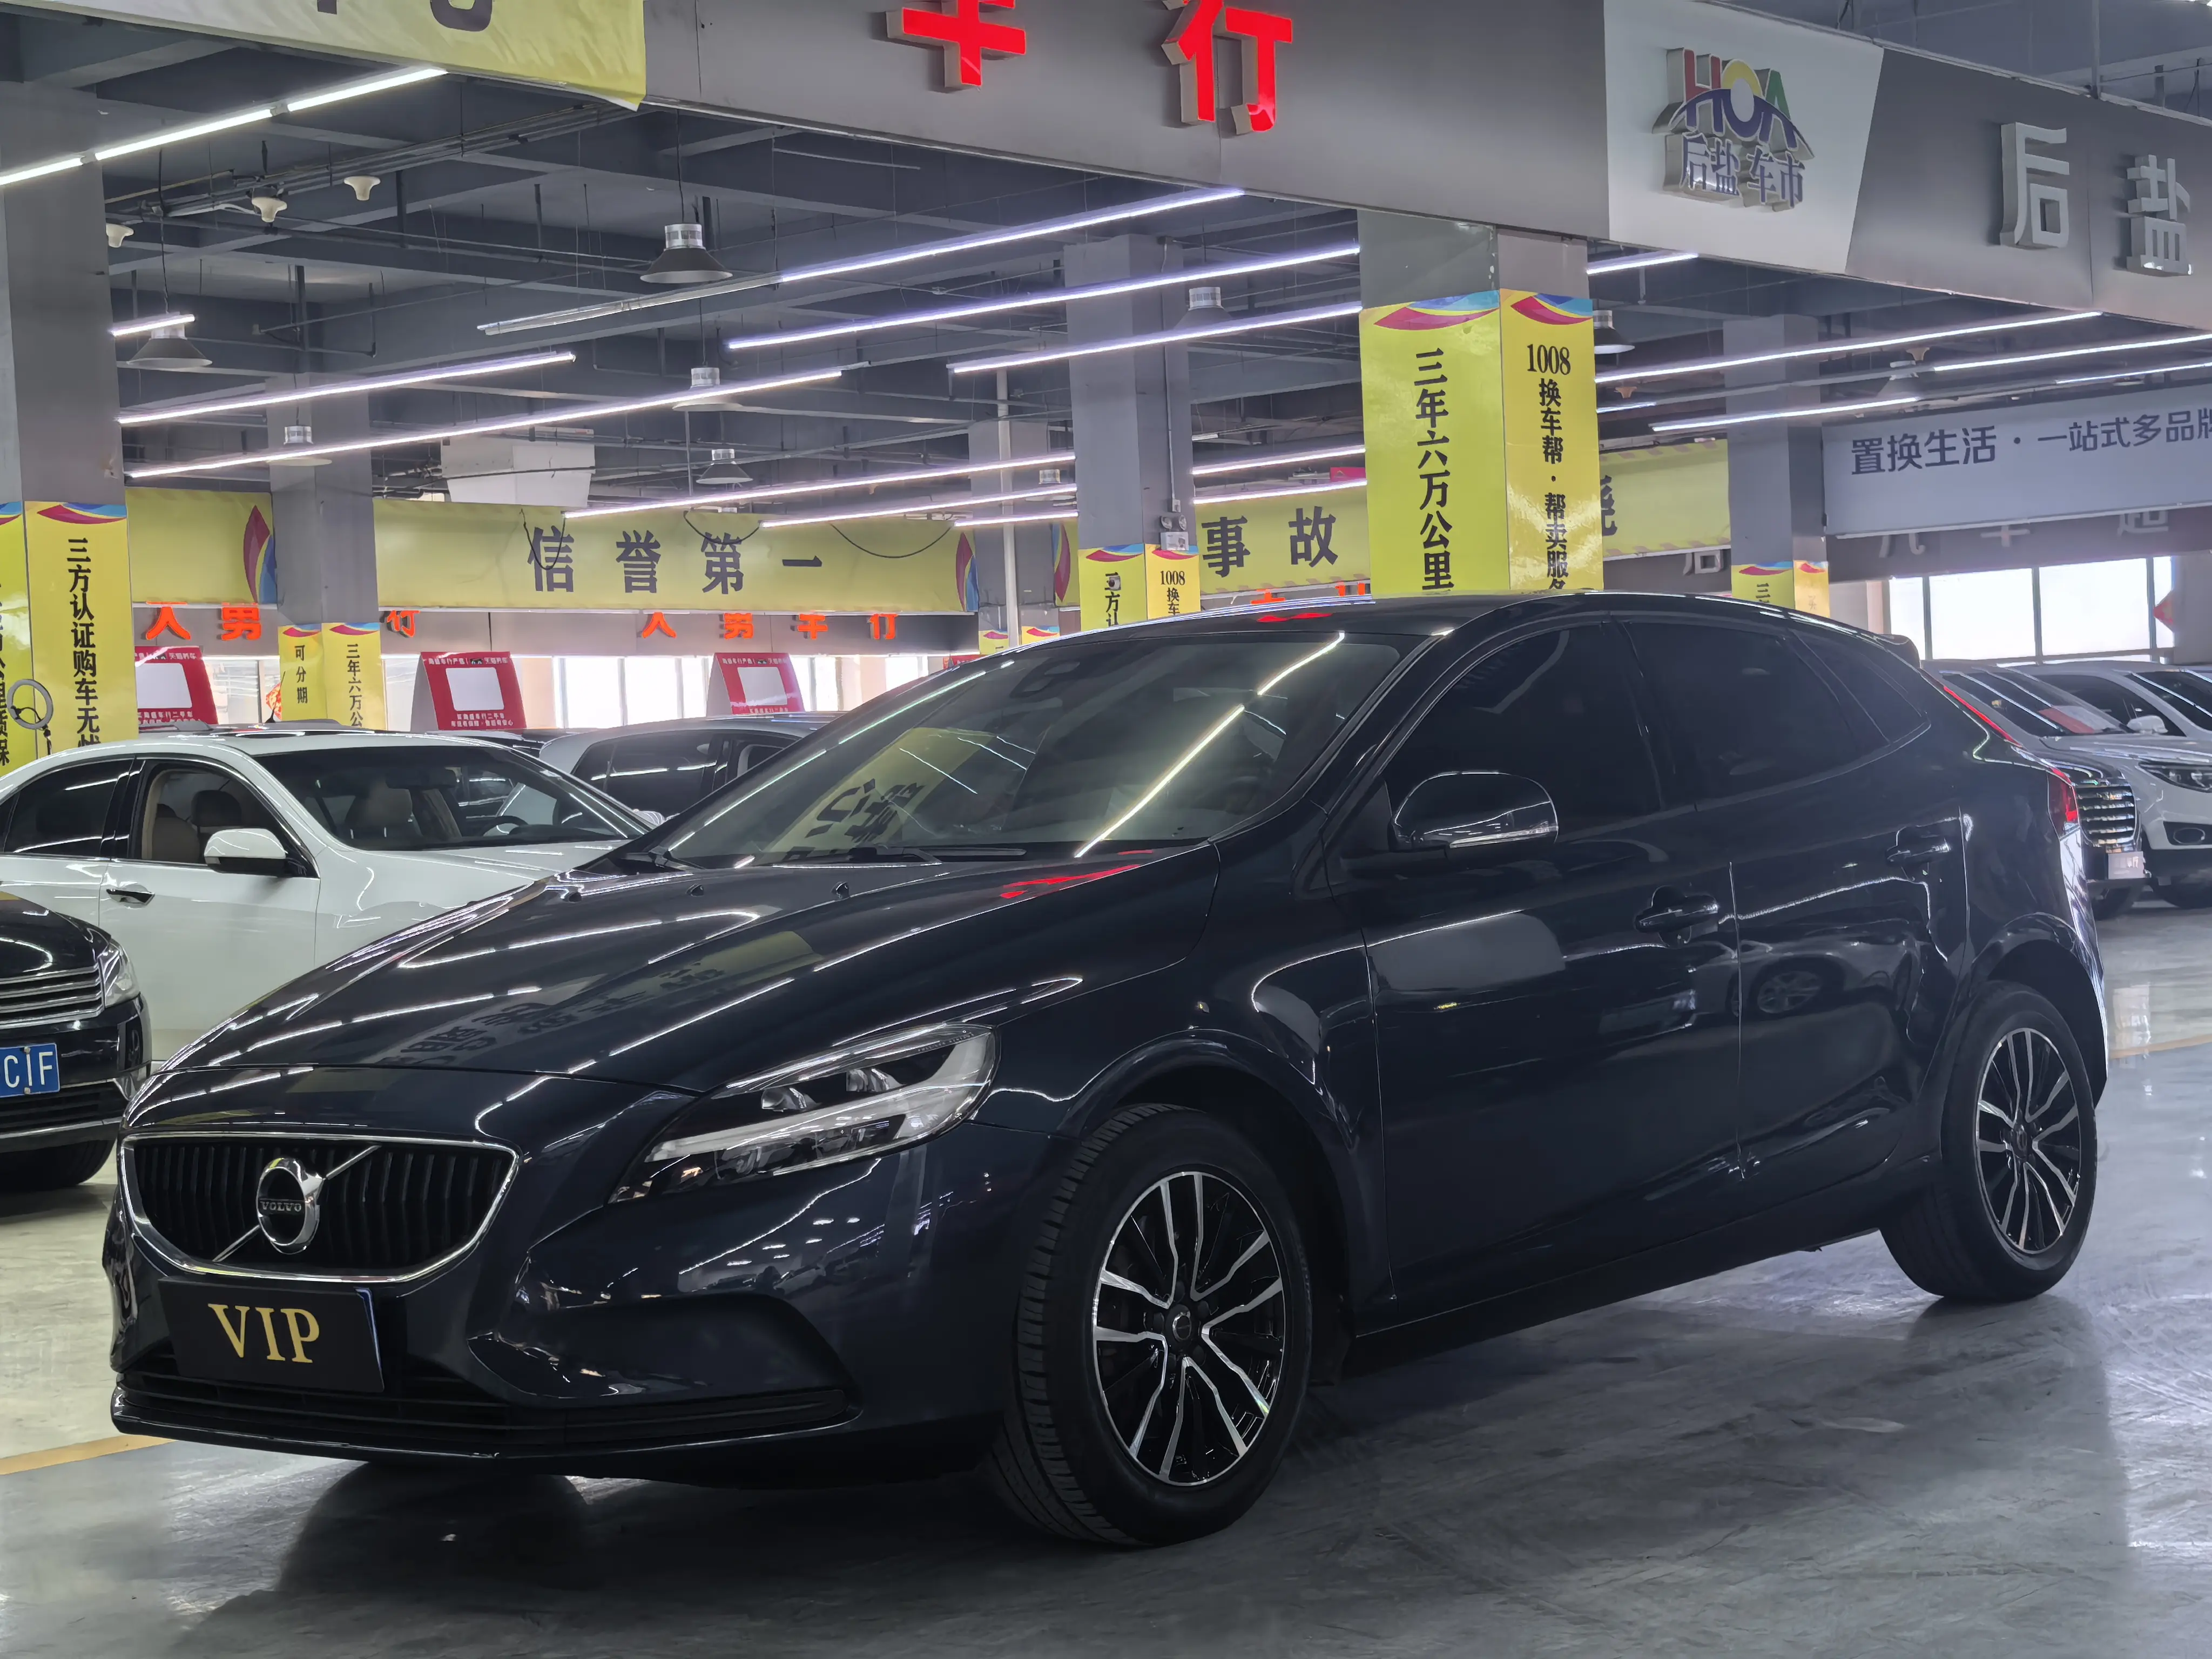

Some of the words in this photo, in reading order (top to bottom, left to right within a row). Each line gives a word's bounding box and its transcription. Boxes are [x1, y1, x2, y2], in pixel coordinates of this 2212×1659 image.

[1526, 343, 1572, 376] 1008
[1414, 347, 1454, 591] 三年六万公里
[527, 525, 822, 595] 信誉第一
[1201, 505, 1338, 578] 事故
[1160, 570, 1185, 585] 1008
[294, 645, 308, 704] 可分期
[346, 643, 364, 727] 三年六万公
[260, 1201, 302, 1212] VOLVO
[208, 1303, 320, 1364] VIP
